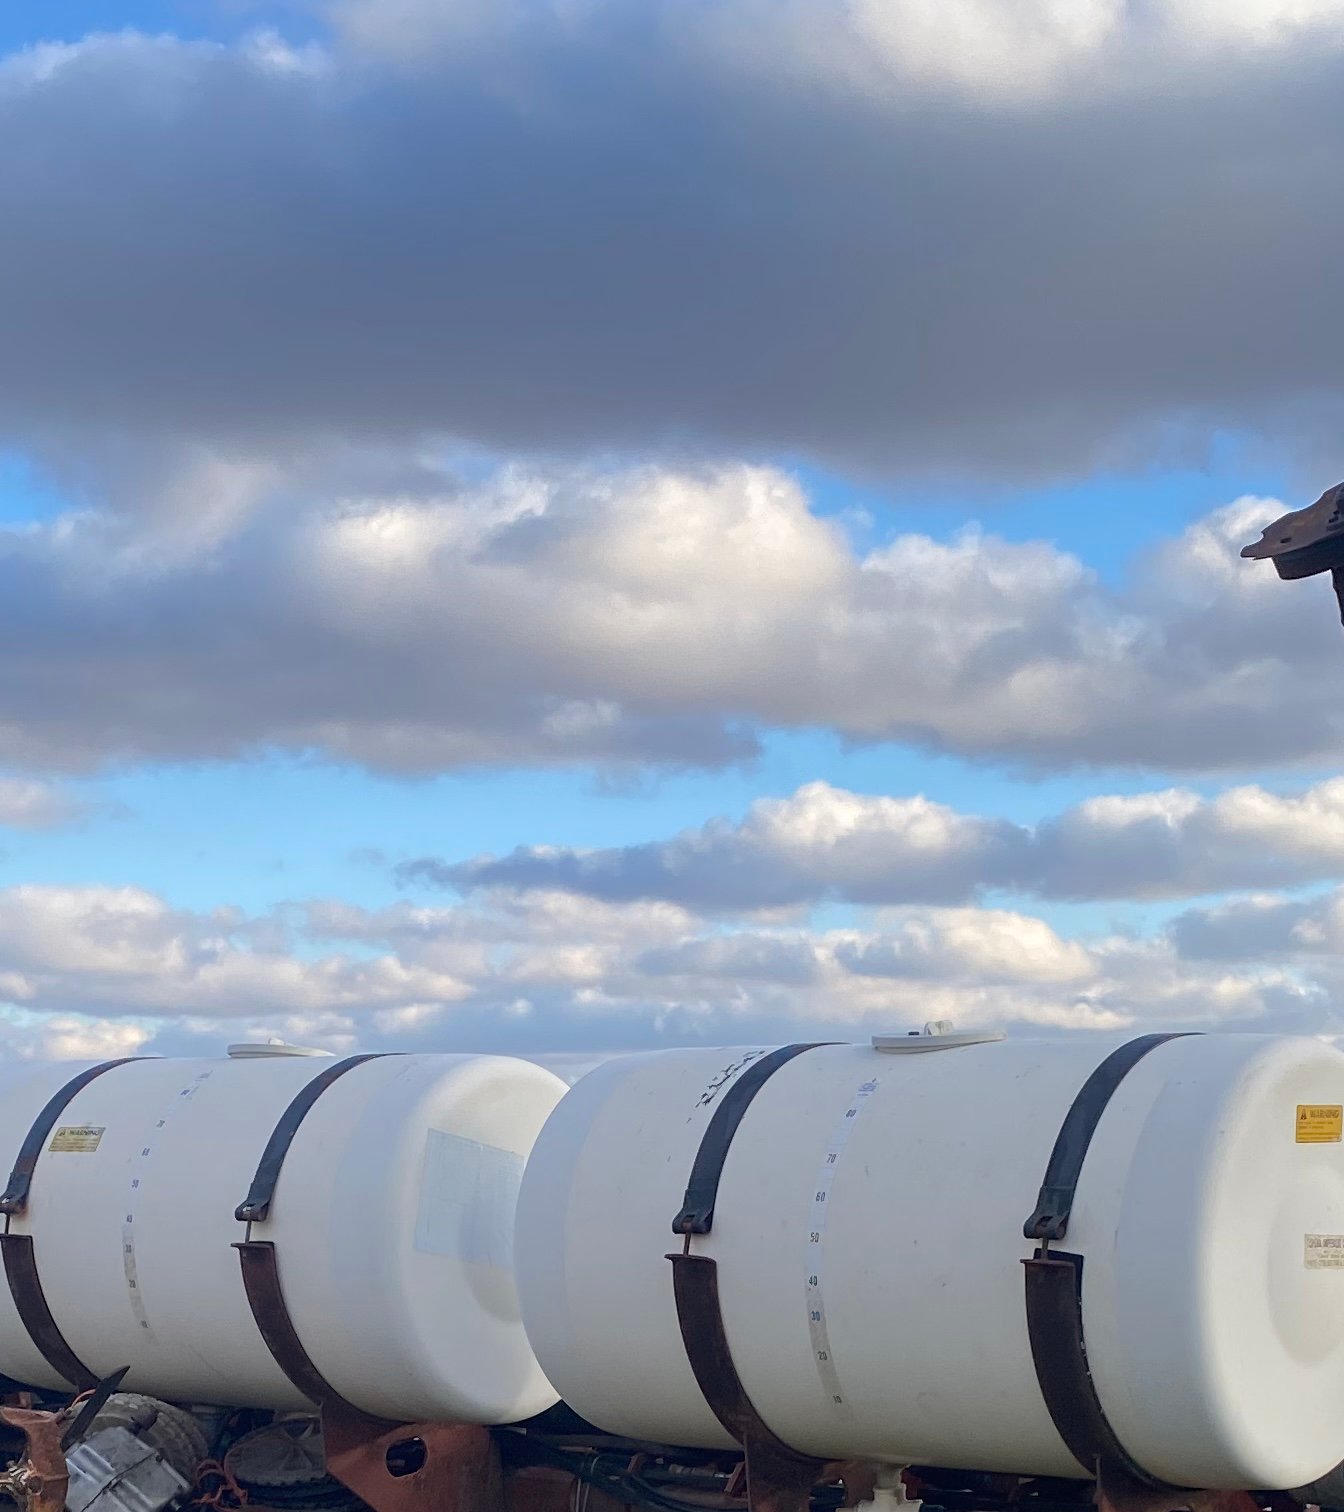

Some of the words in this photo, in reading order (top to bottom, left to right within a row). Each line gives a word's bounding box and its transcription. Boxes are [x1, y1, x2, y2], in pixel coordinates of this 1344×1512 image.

[826, 1153, 837, 1164] 70
[815, 1191, 826, 1202] 60
[809, 1232, 820, 1243] 50
[808, 1275, 818, 1287] 40
[811, 1310, 821, 1321] 30
[817, 1351, 828, 1361] 20
